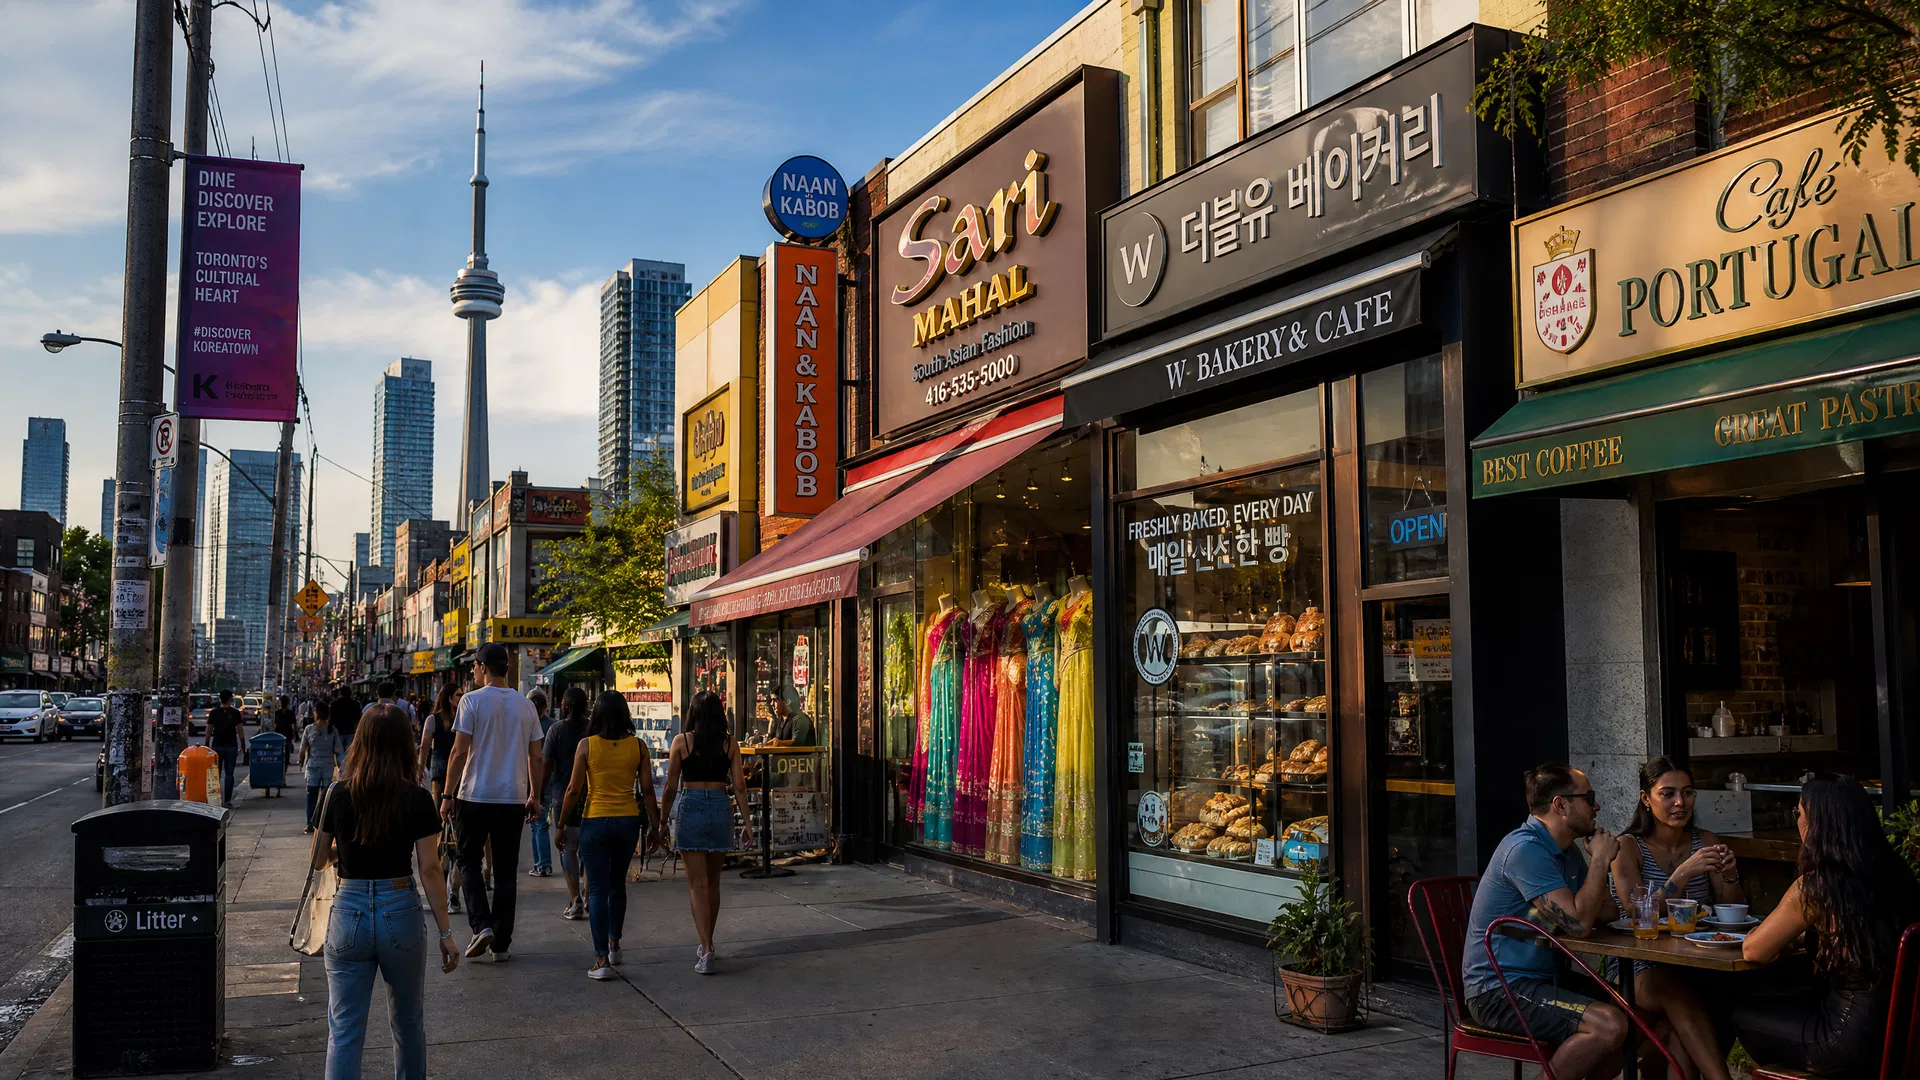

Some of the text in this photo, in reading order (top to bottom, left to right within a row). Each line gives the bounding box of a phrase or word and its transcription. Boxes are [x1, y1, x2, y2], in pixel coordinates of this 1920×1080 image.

[199, 170, 235, 189] DINE
[782, 172, 837, 196] NAAN
[1181, 93, 1442, 263] 더블유 베이커리
[1715, 147, 1840, 233] Café
[198, 191, 274, 212] DISCOVER
[780, 195, 839, 219] KABOB
[197, 211, 266, 232] EXPLORE
[891, 149, 1060, 306] Sari
[195, 251, 268, 270] TORONTO'S
[1120, 233, 1154, 286] W
[1617, 201, 1920, 337] PORTUGAL
[194, 287, 239, 304] HEART
[195, 269, 260, 287] CULTURAL
[911, 264, 1036, 348] MAHAL
[193, 327, 251, 341] #DISCOVER
[193, 340, 259, 355] KOREATOWN
[911, 320, 1034, 383] South Asian Fashion
[1165, 358, 1188, 391] W
[1196, 325, 1287, 382] BAKERY
[1315, 290, 1394, 344] CAFE
[193, 373, 218, 399] K
[794, 263, 819, 497] NAAN & KABOB
[925, 354, 1020, 406] 416-535-5000
[1714, 381, 1920, 447] GREAT PASTR
[1482, 435, 1623, 486] BEST COFFEE
[1128, 490, 1315, 541] FRESHLY BAKED, EVERY DAY
[1390, 512, 1443, 544] OPEN
[1264, 523, 1291, 563] 빵
[777, 757, 816, 774] OPEN
[136, 910, 187, 931] Litter
